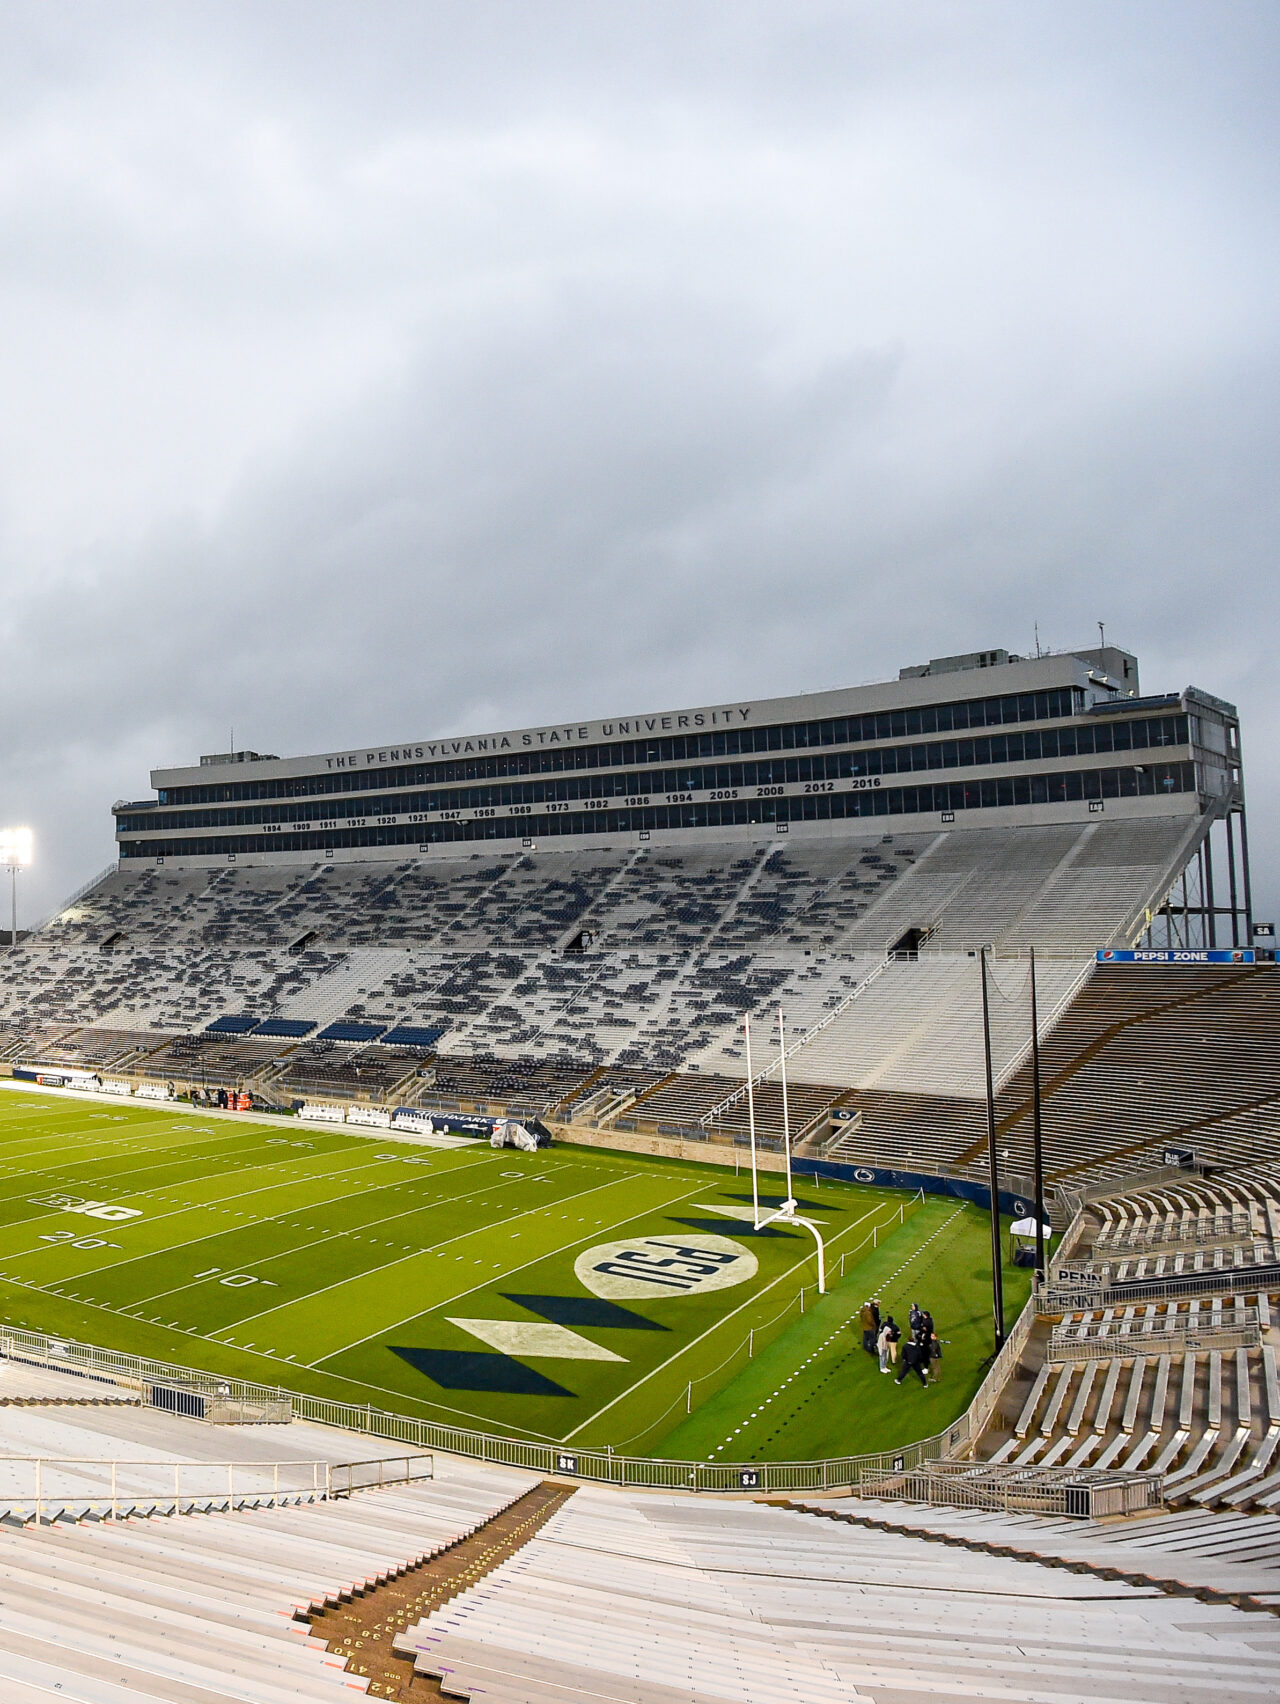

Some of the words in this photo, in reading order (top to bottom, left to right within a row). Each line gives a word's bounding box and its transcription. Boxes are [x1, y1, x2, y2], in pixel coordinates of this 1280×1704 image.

[326, 755, 357, 769] THE
[366, 737, 511, 764] PENNSYLVANIA
[522, 727, 588, 746] STATE
[602, 708, 751, 737] UNIVERSITY
[263, 825, 281, 833] 1894
[293, 823, 310, 831] 1909
[320, 821, 337, 829] 1911
[347, 819, 366, 827] 1912
[377, 817, 397, 825] 1920
[408, 814, 428, 822] 1921
[440, 811, 461, 820] 1947
[474, 809, 495, 818] 1968
[508, 806, 531, 815] 1969
[545, 803, 569, 812] 1973
[584, 800, 608, 809] 1982
[624, 797, 650, 806] 1986
[666, 793, 693, 803] 1994
[710, 790, 738, 800] 2005
[757, 786, 784, 796] 2008
[804, 783, 834, 793] 2012
[852, 778, 881, 789] 2016
[1256, 927, 1270, 935] SA
[1133, 952, 1169, 961] PEPSI
[1173, 952, 1209, 961] ZONE
[38, 1231, 108, 1250] 20
[592, 1240, 741, 1289] PSU
[193, 1267, 259, 1288] 10
[1058, 1270, 1102, 1284] PENN
[559, 1455, 575, 1470] SK
[742, 1475, 757, 1485] SJ
[406, 1603, 422, 1611] 34
[386, 1616, 405, 1625] 36
[373, 1623, 394, 1633] 37
[361, 1630, 381, 1640] 38
[343, 1637, 364, 1648] 39
[334, 1647, 355, 1658] 40
[350, 1663, 368, 1673] 41
[371, 1682, 395, 1694] 42
